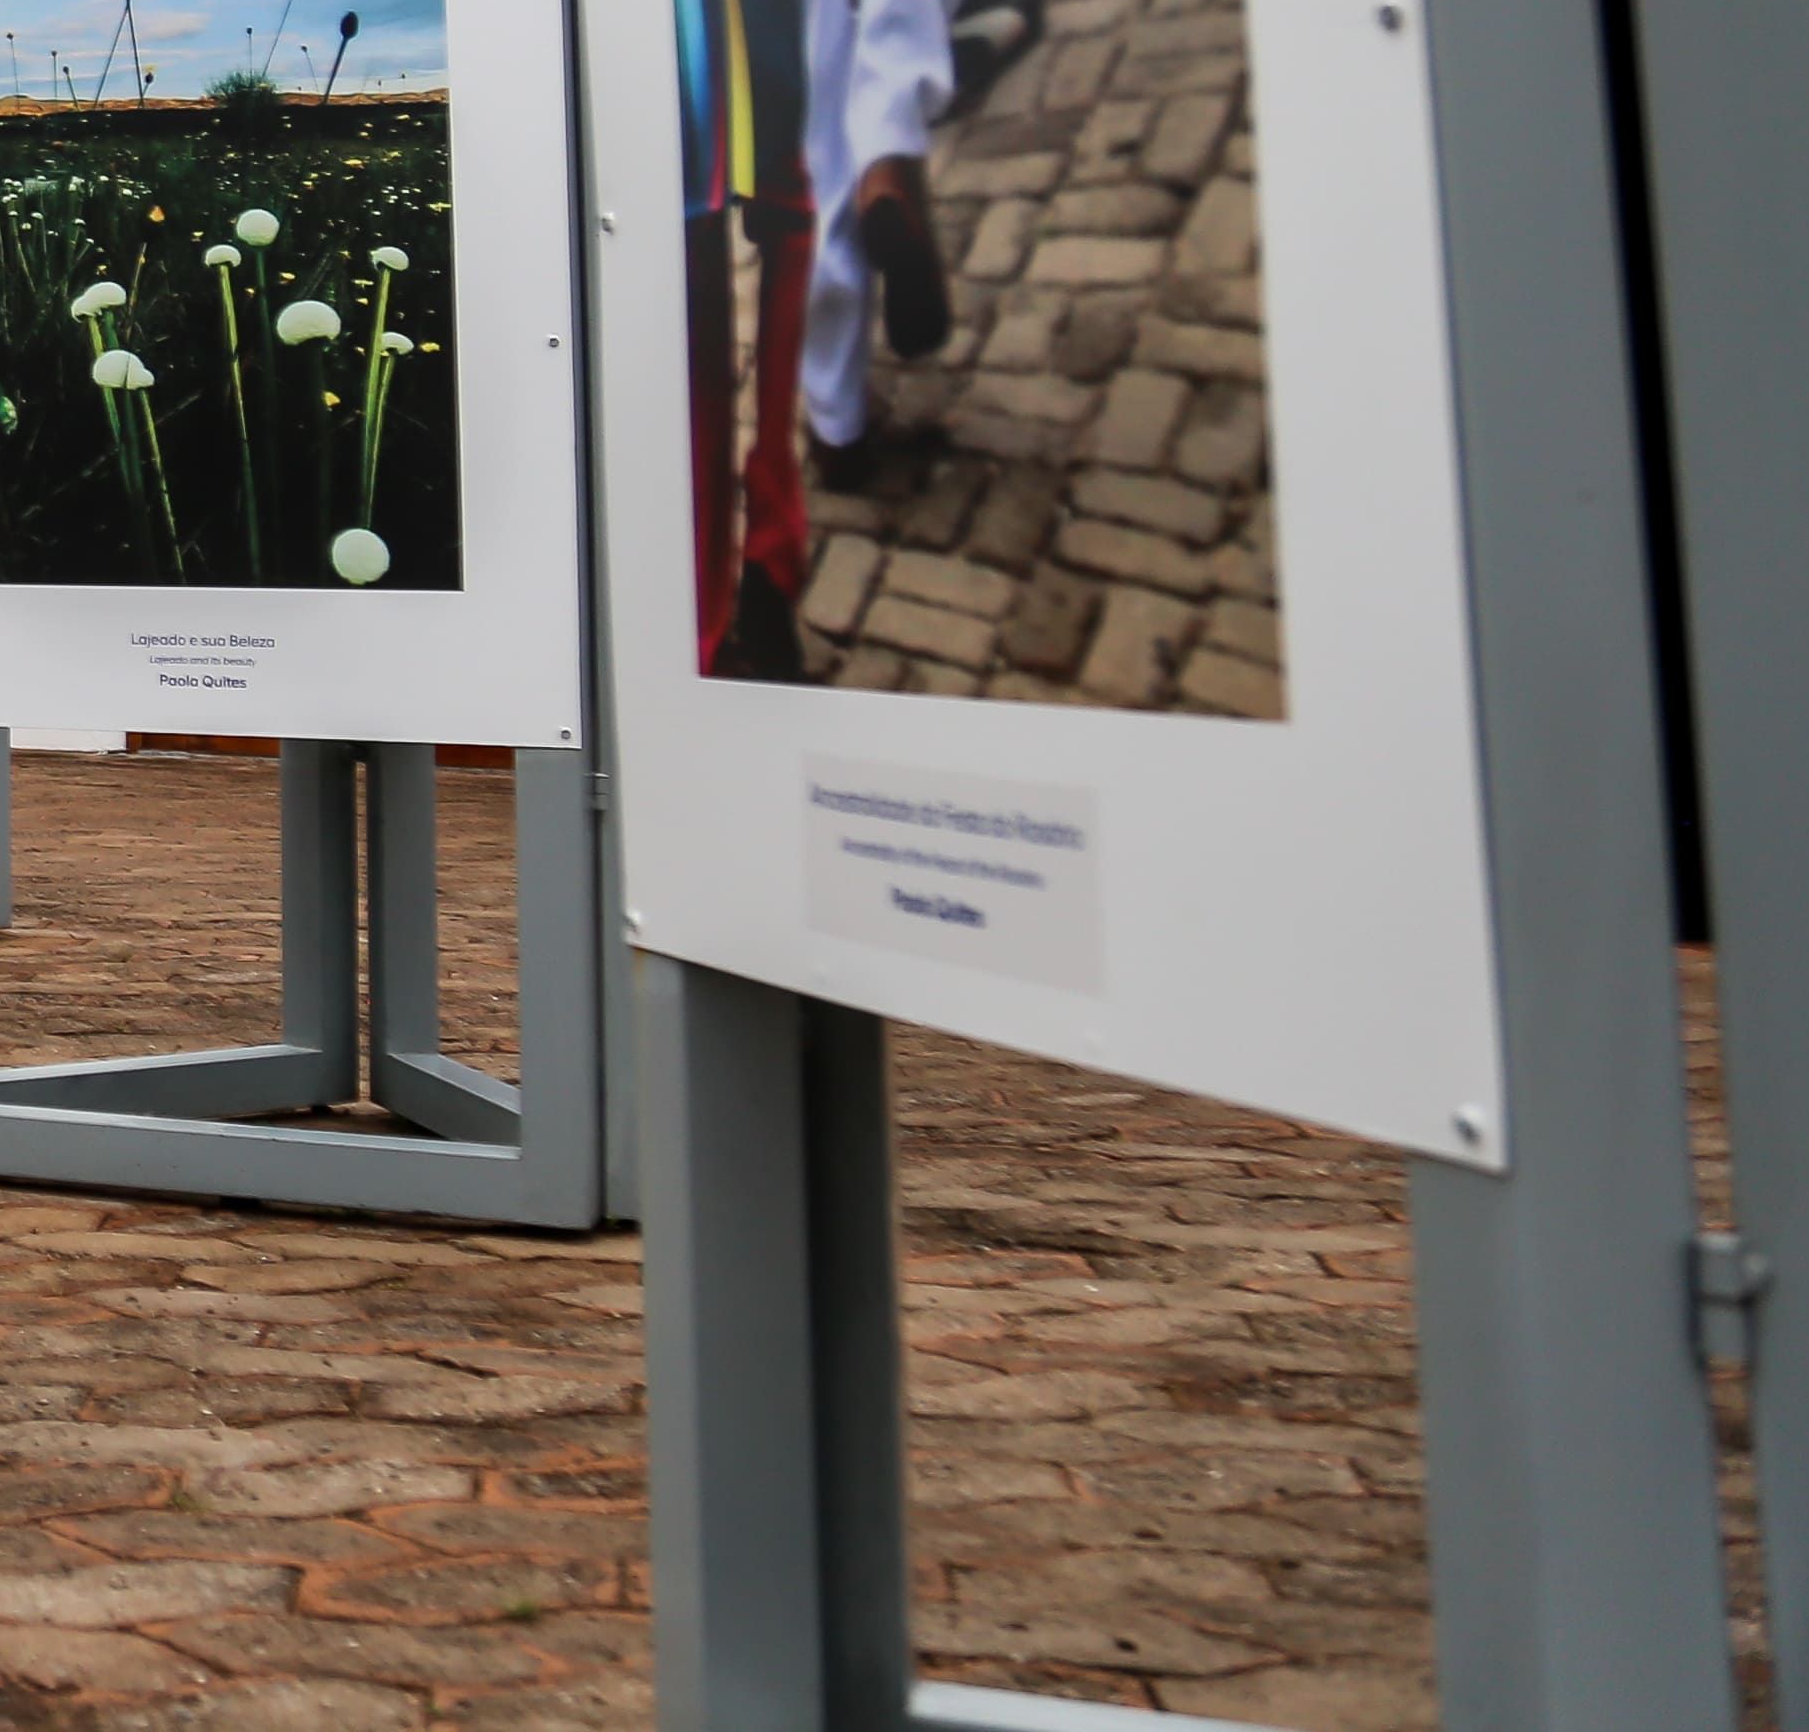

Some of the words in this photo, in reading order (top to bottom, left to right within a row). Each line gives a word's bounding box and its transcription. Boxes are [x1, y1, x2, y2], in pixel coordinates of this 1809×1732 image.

[131, 633, 186, 648] Lajeado
[201, 637, 226, 647] sua
[229, 634, 275, 648] Beleza
[159, 674, 199, 687] Paola
[202, 675, 247, 688] Quites
